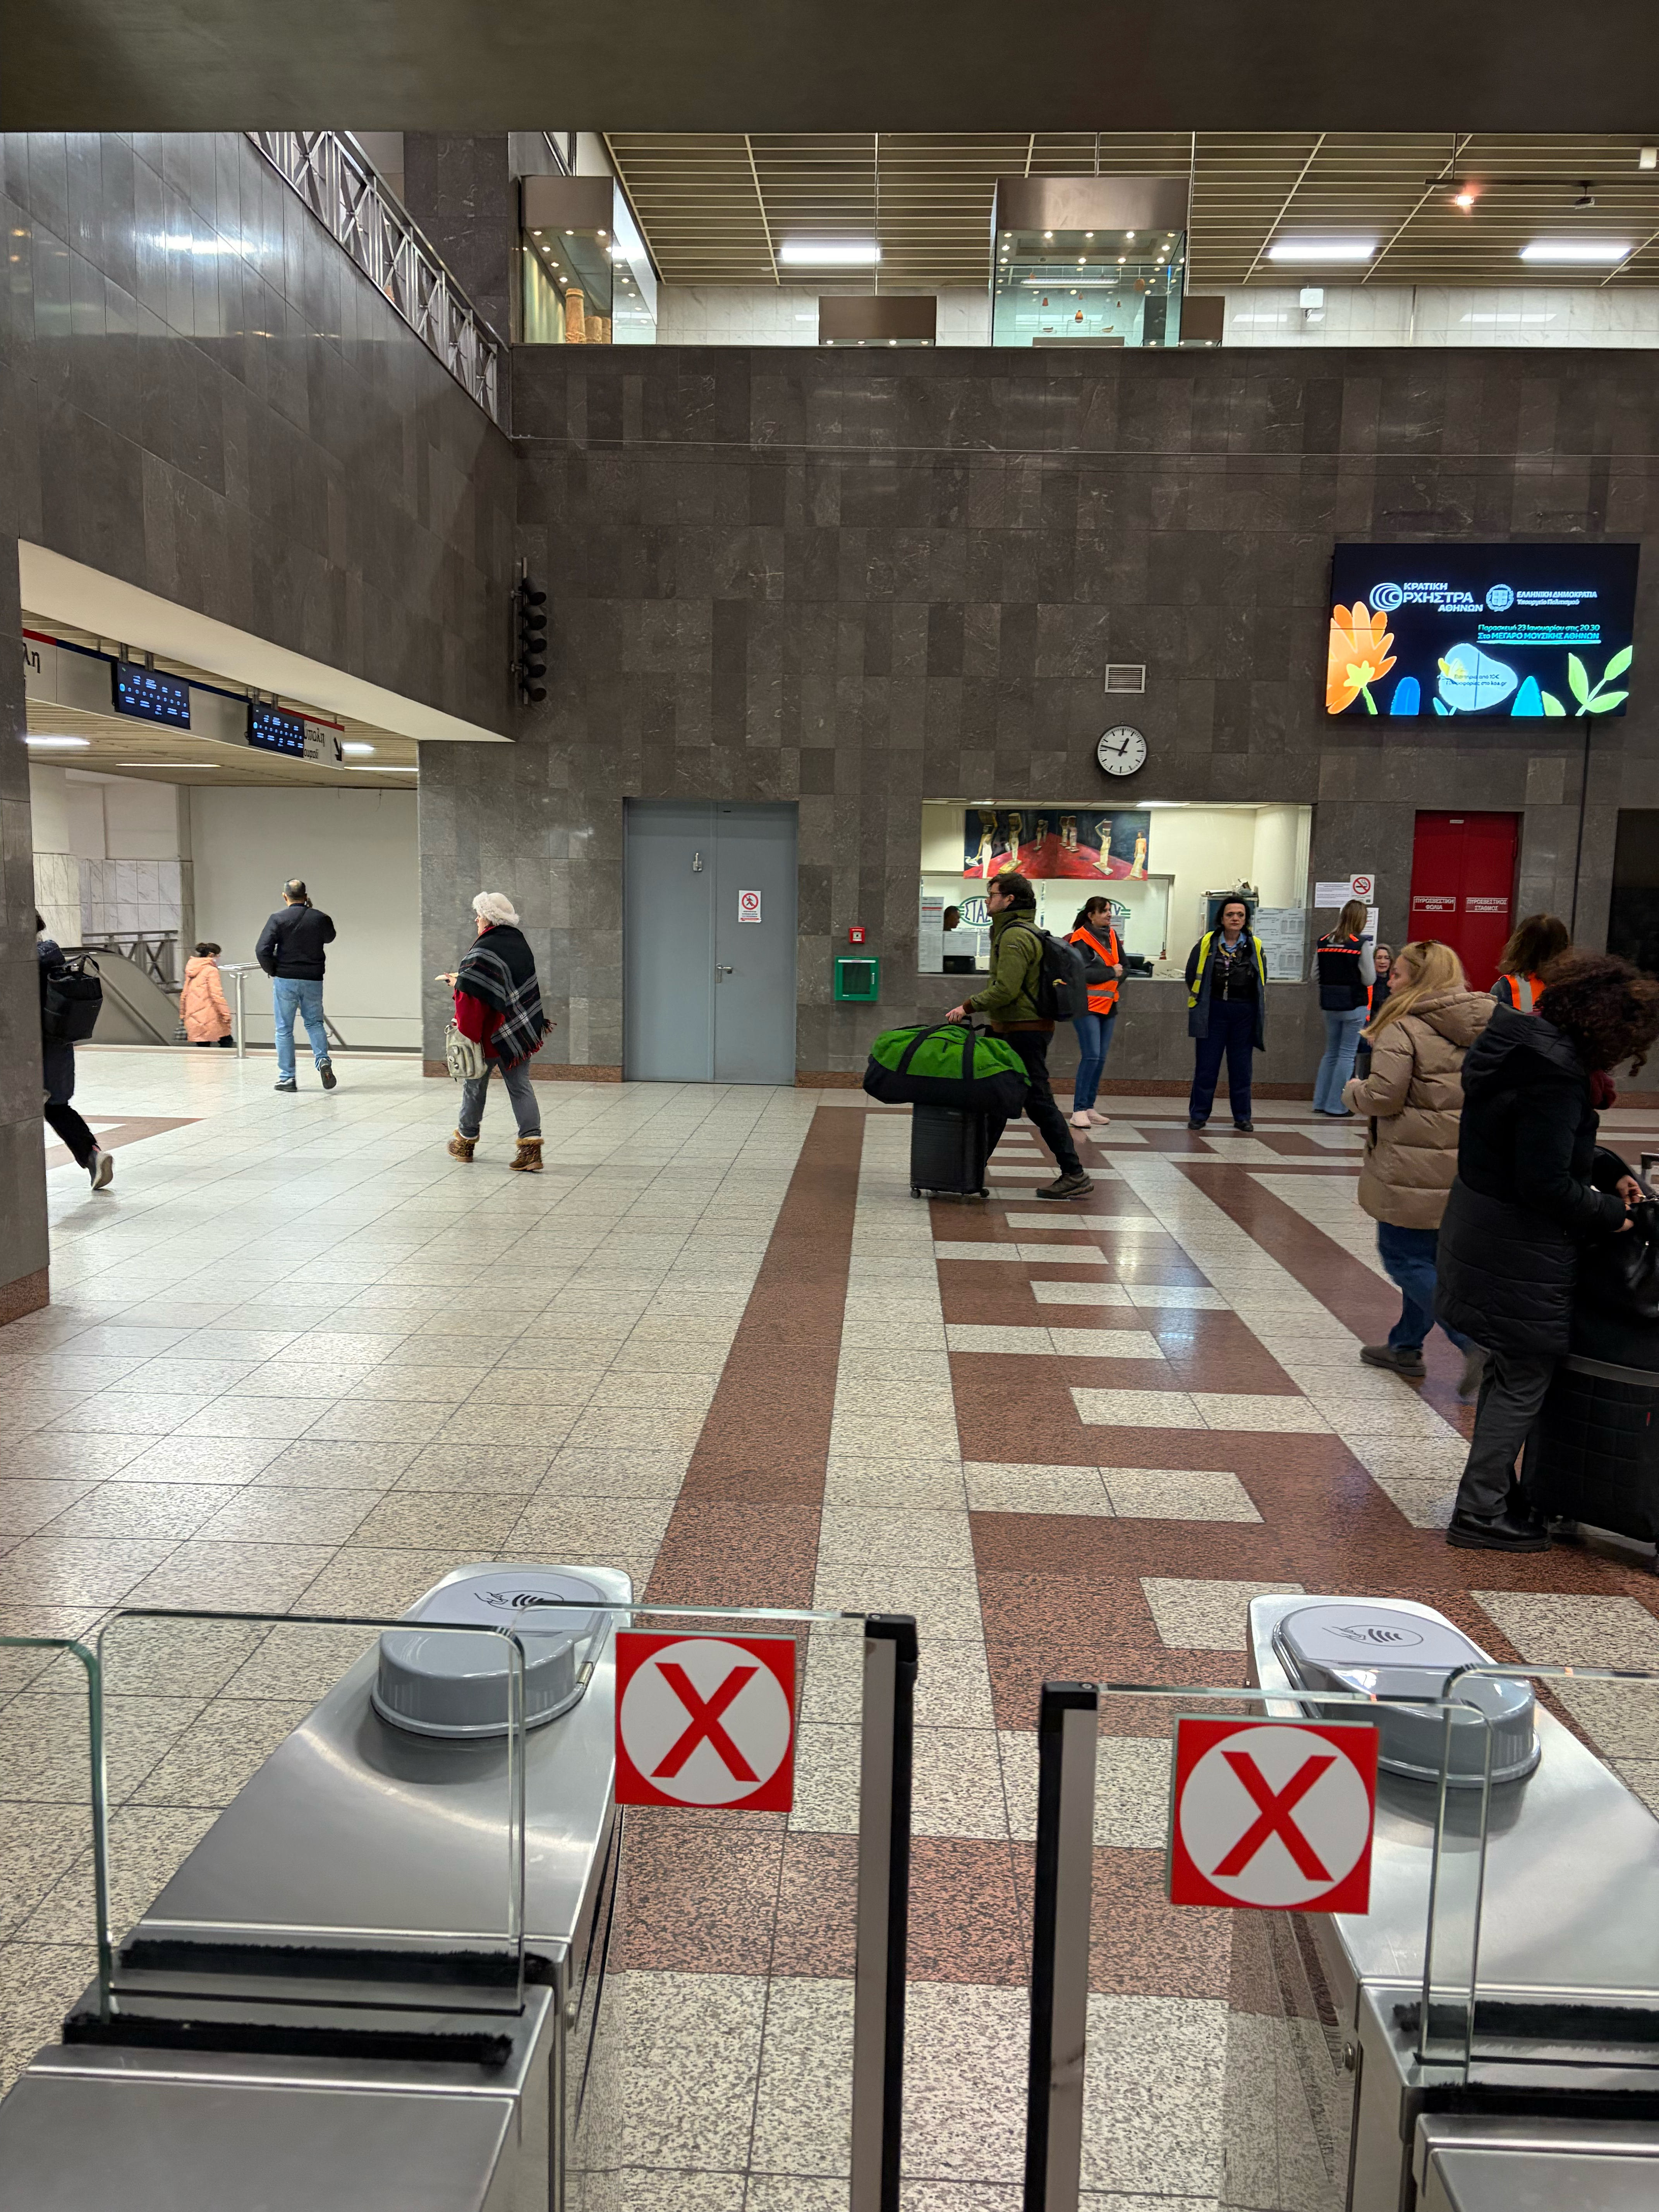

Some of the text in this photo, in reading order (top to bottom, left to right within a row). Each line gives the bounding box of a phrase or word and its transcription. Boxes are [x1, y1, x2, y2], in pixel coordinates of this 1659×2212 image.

[1403, 582, 1448, 591] ΚΡΑΤΙΚΗ
[1437, 604, 1484, 612] ΑΘΗΝΩΝ
[1478, 624, 1517, 632] Παρασκευή
